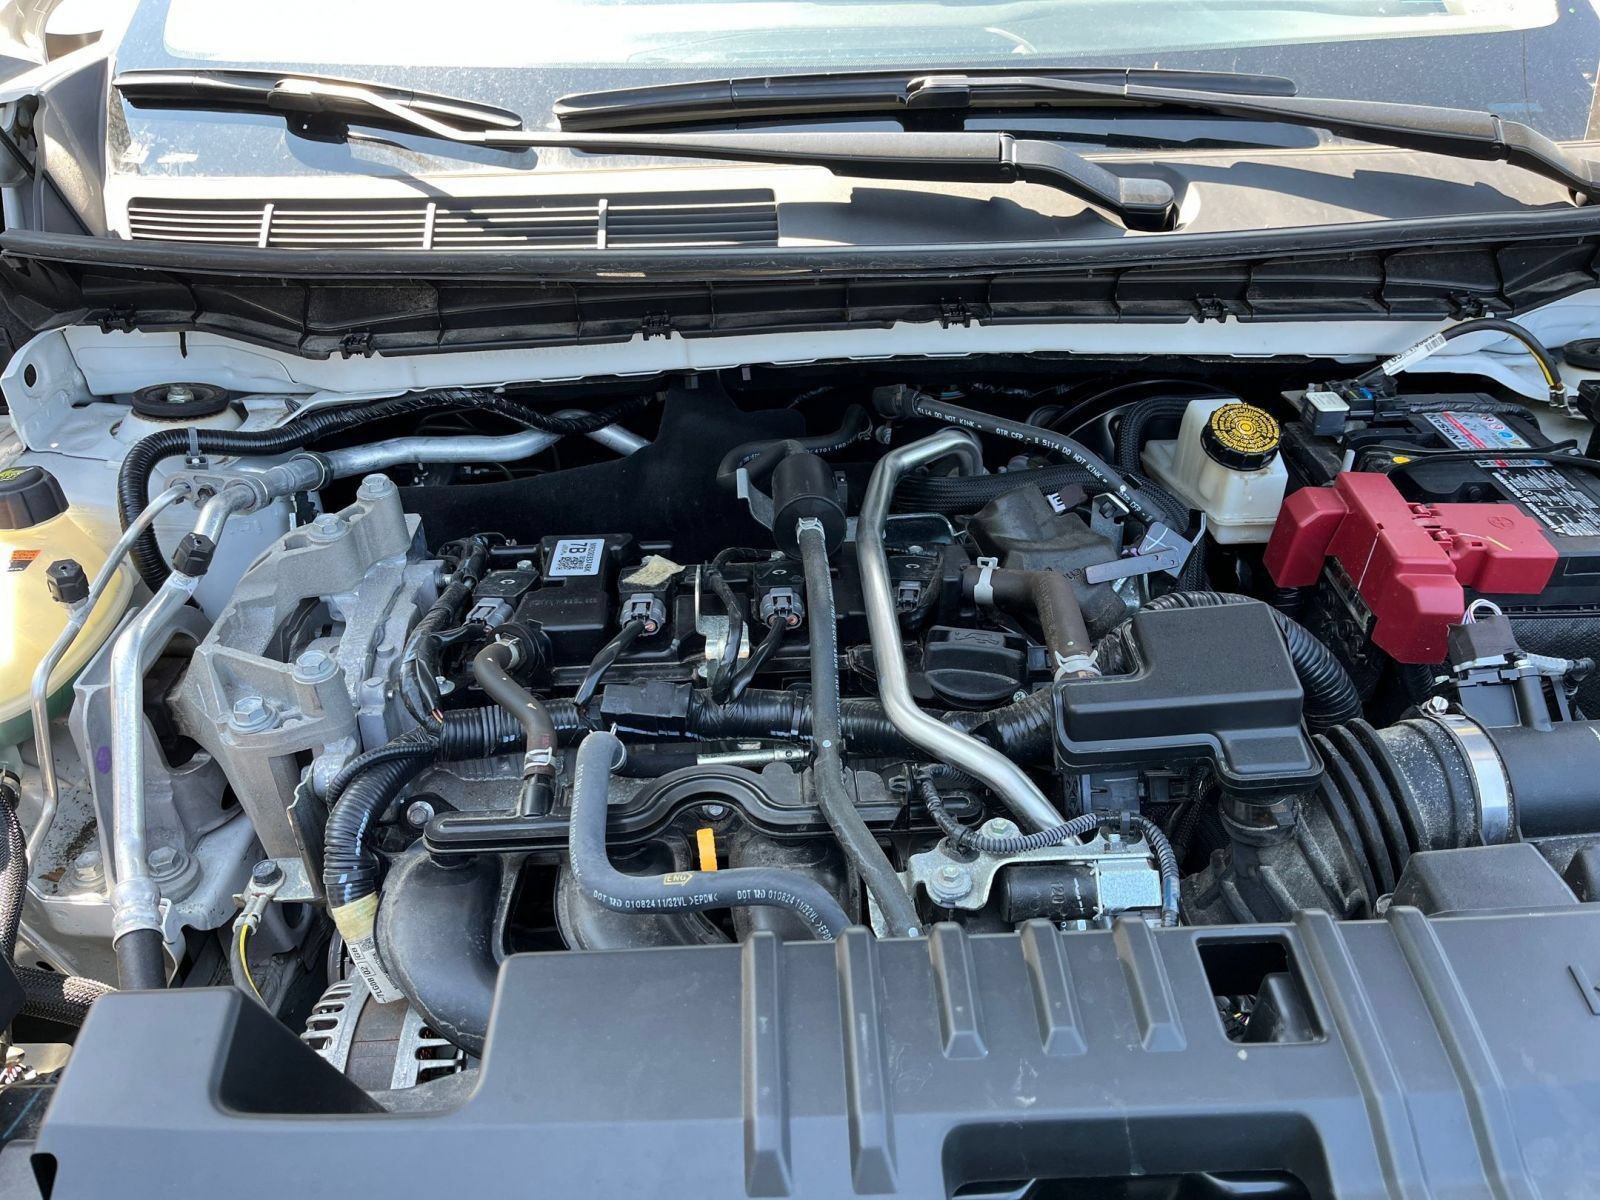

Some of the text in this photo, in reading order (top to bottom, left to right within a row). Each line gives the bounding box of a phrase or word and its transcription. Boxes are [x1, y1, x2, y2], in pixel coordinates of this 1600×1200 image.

[1062, 446, 1072, 456] DO
[1072, 452, 1086, 465] NOT
[1086, 463, 1102, 479] KINK
[569, 542, 588, 554] 7B
[593, 890, 607, 902] DOT
[624, 900, 656, 908] 010824
[736, 890, 751, 900] DOT
